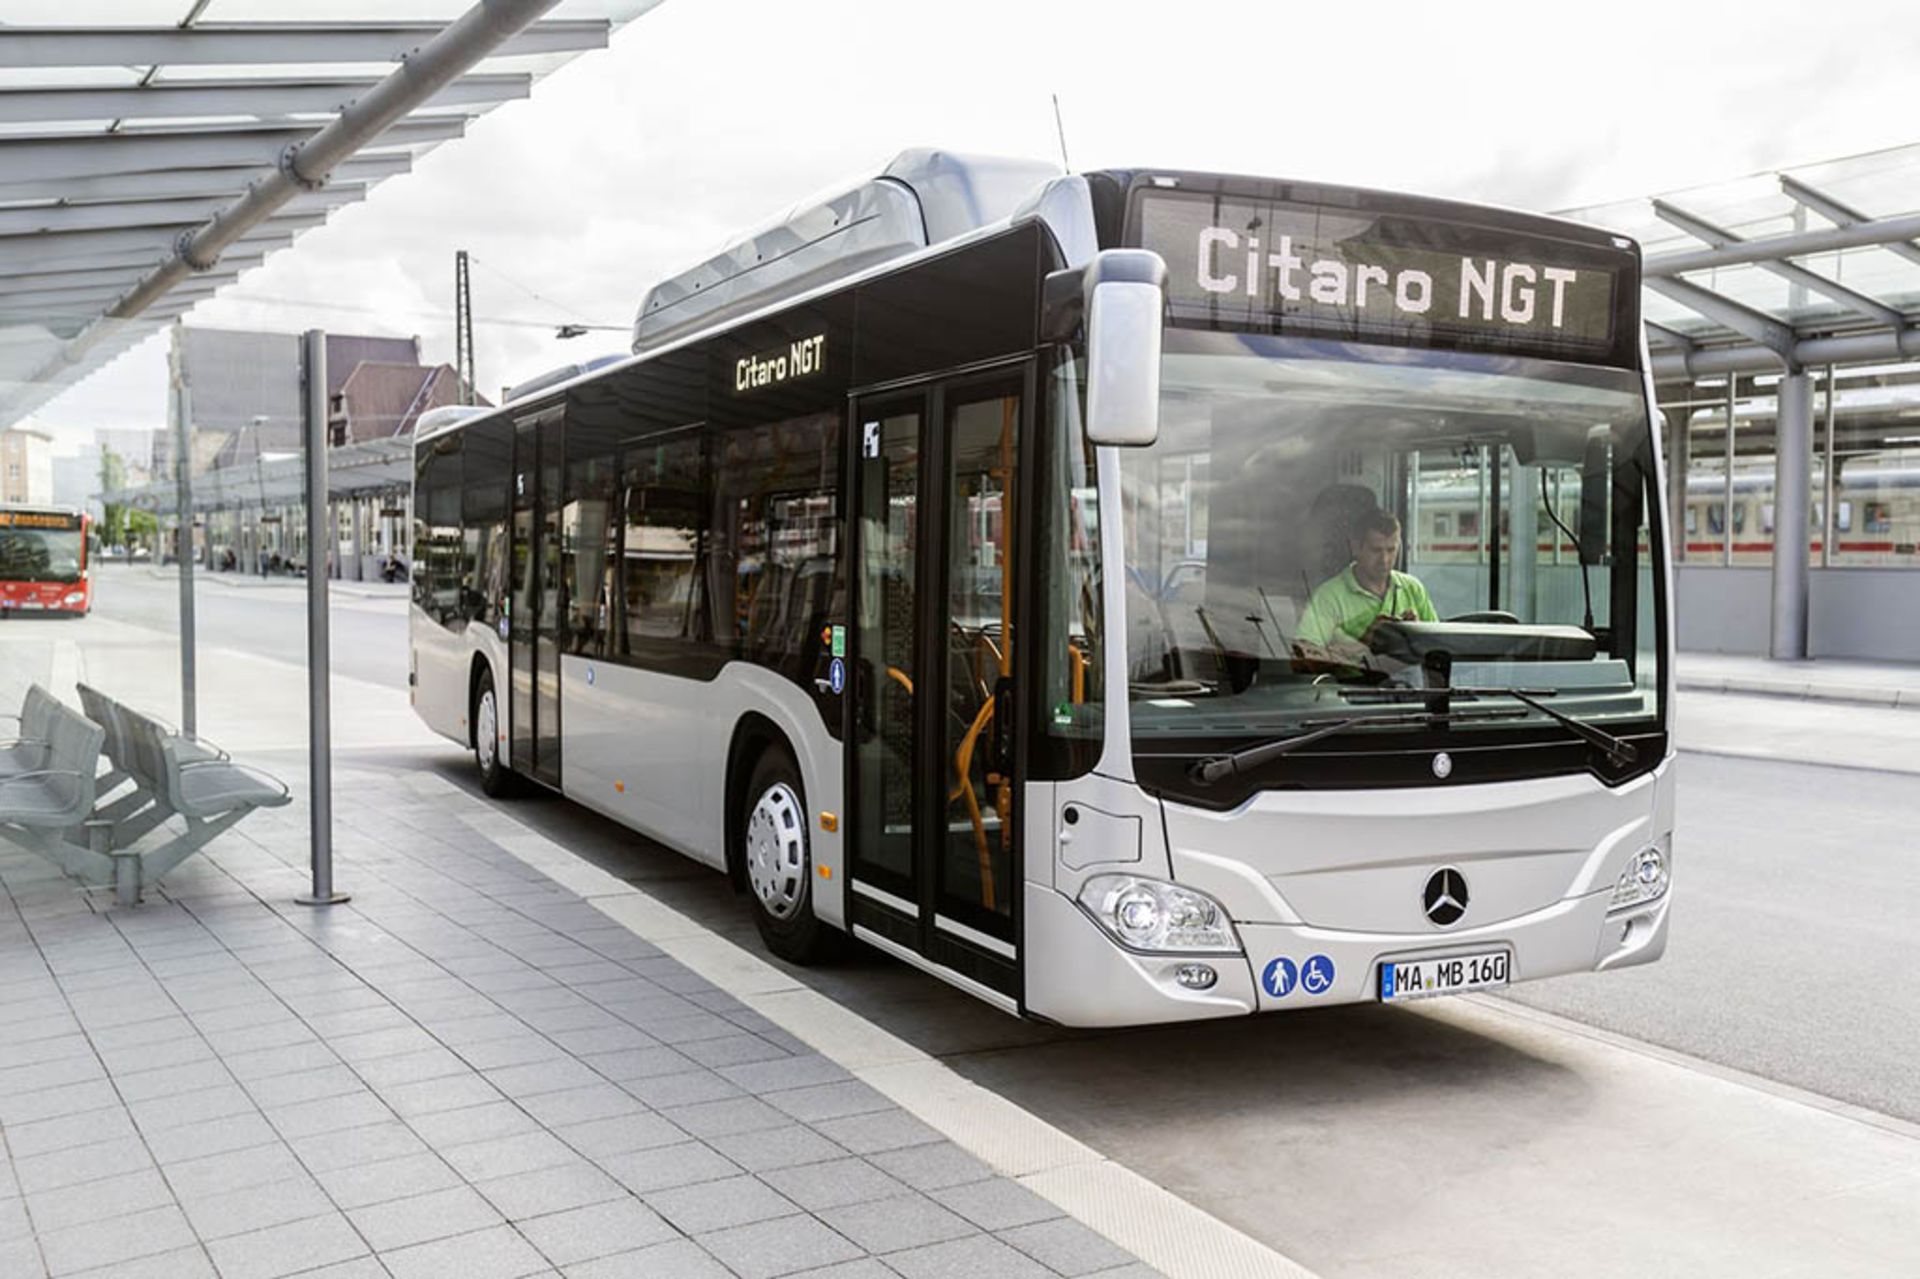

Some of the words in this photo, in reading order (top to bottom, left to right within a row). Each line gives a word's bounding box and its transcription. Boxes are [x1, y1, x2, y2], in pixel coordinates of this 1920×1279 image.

[1197, 227, 1432, 313] Citaro
[1459, 257, 1576, 327] NGT
[736, 355, 786, 390] Citaro
[790, 335, 824, 377] NGT
[1395, 966, 1422, 992] MA
[1437, 961, 1463, 988] MB
[1468, 957, 1505, 984] 160
